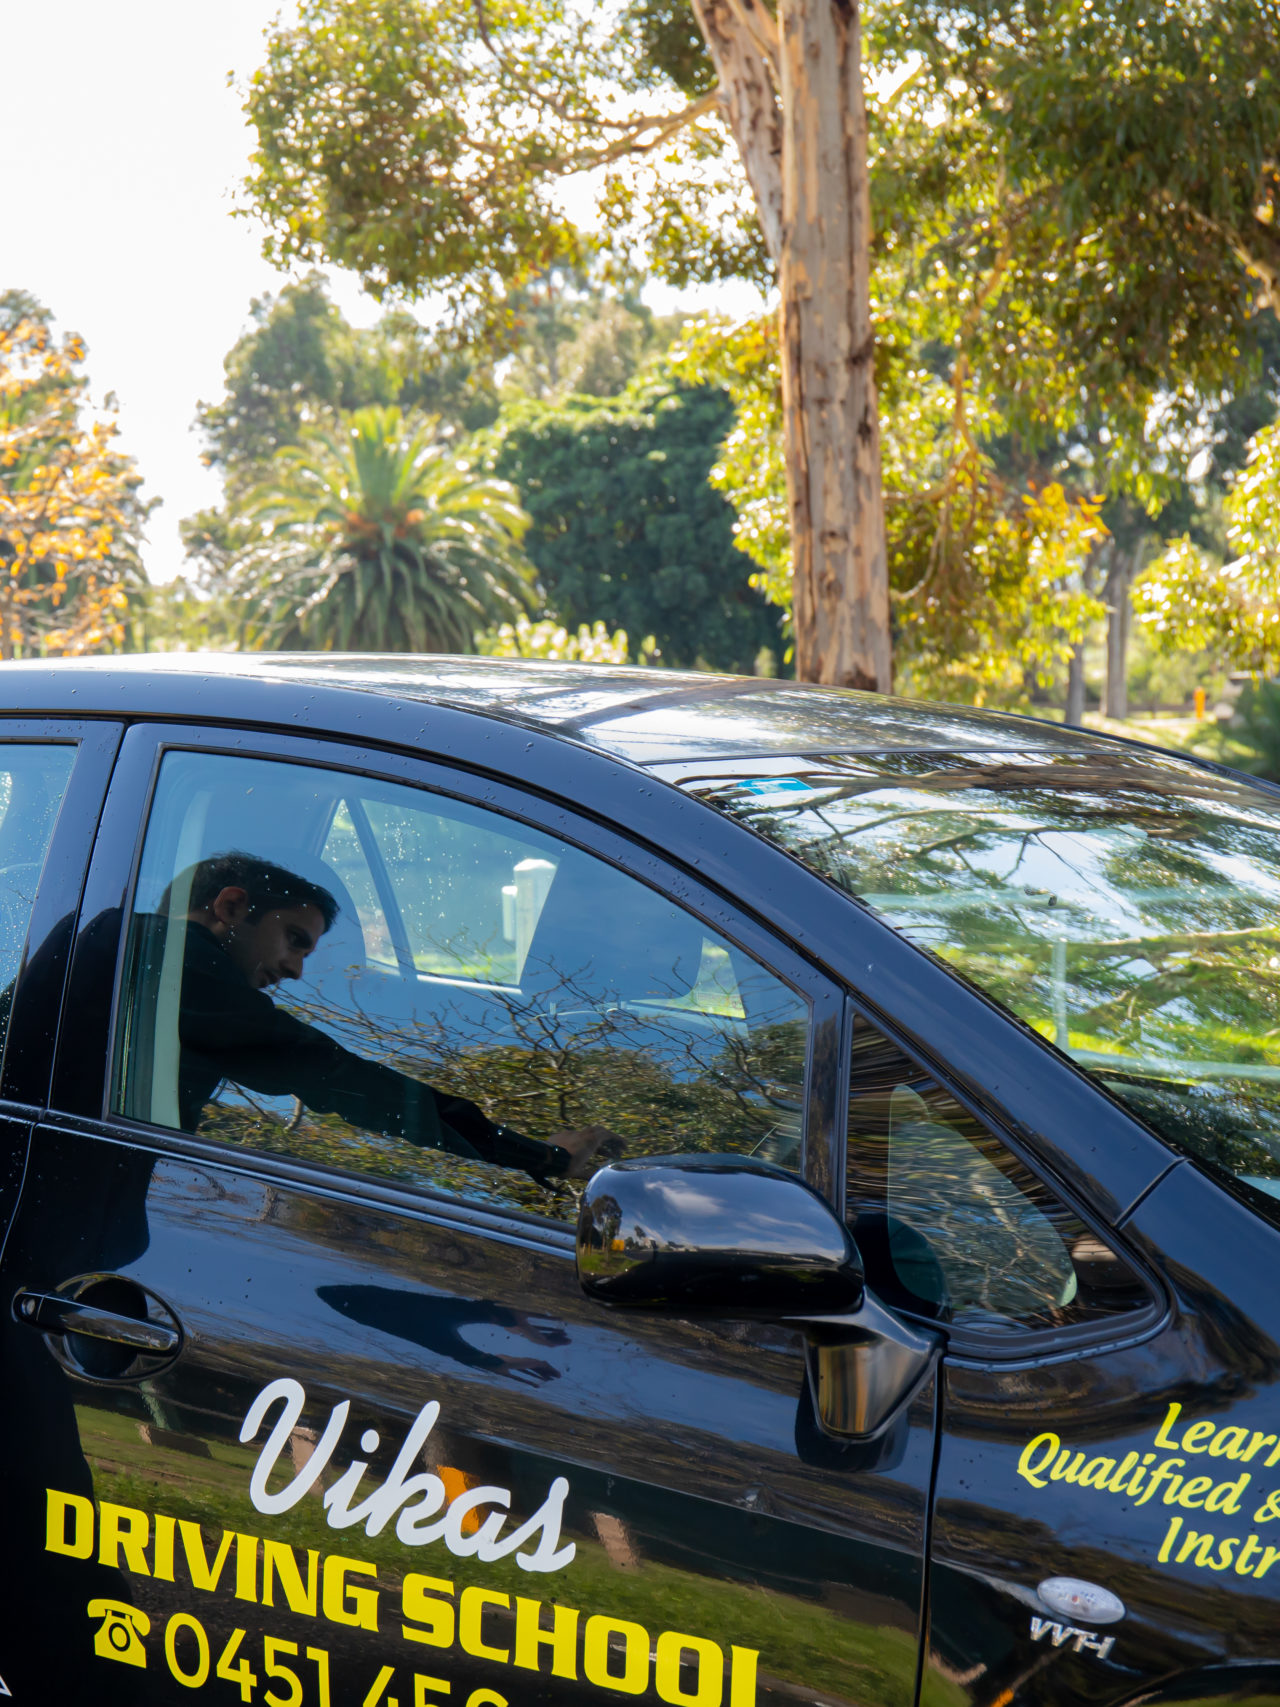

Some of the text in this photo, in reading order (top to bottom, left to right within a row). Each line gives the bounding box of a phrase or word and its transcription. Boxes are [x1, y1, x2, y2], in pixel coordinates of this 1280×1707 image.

[240, 1378, 576, 1572] Vikas
[1017, 1432, 1251, 1515] Qualified
[45, 1488, 380, 1633] DRIVING
[165, 1612, 331, 1707] 0451
